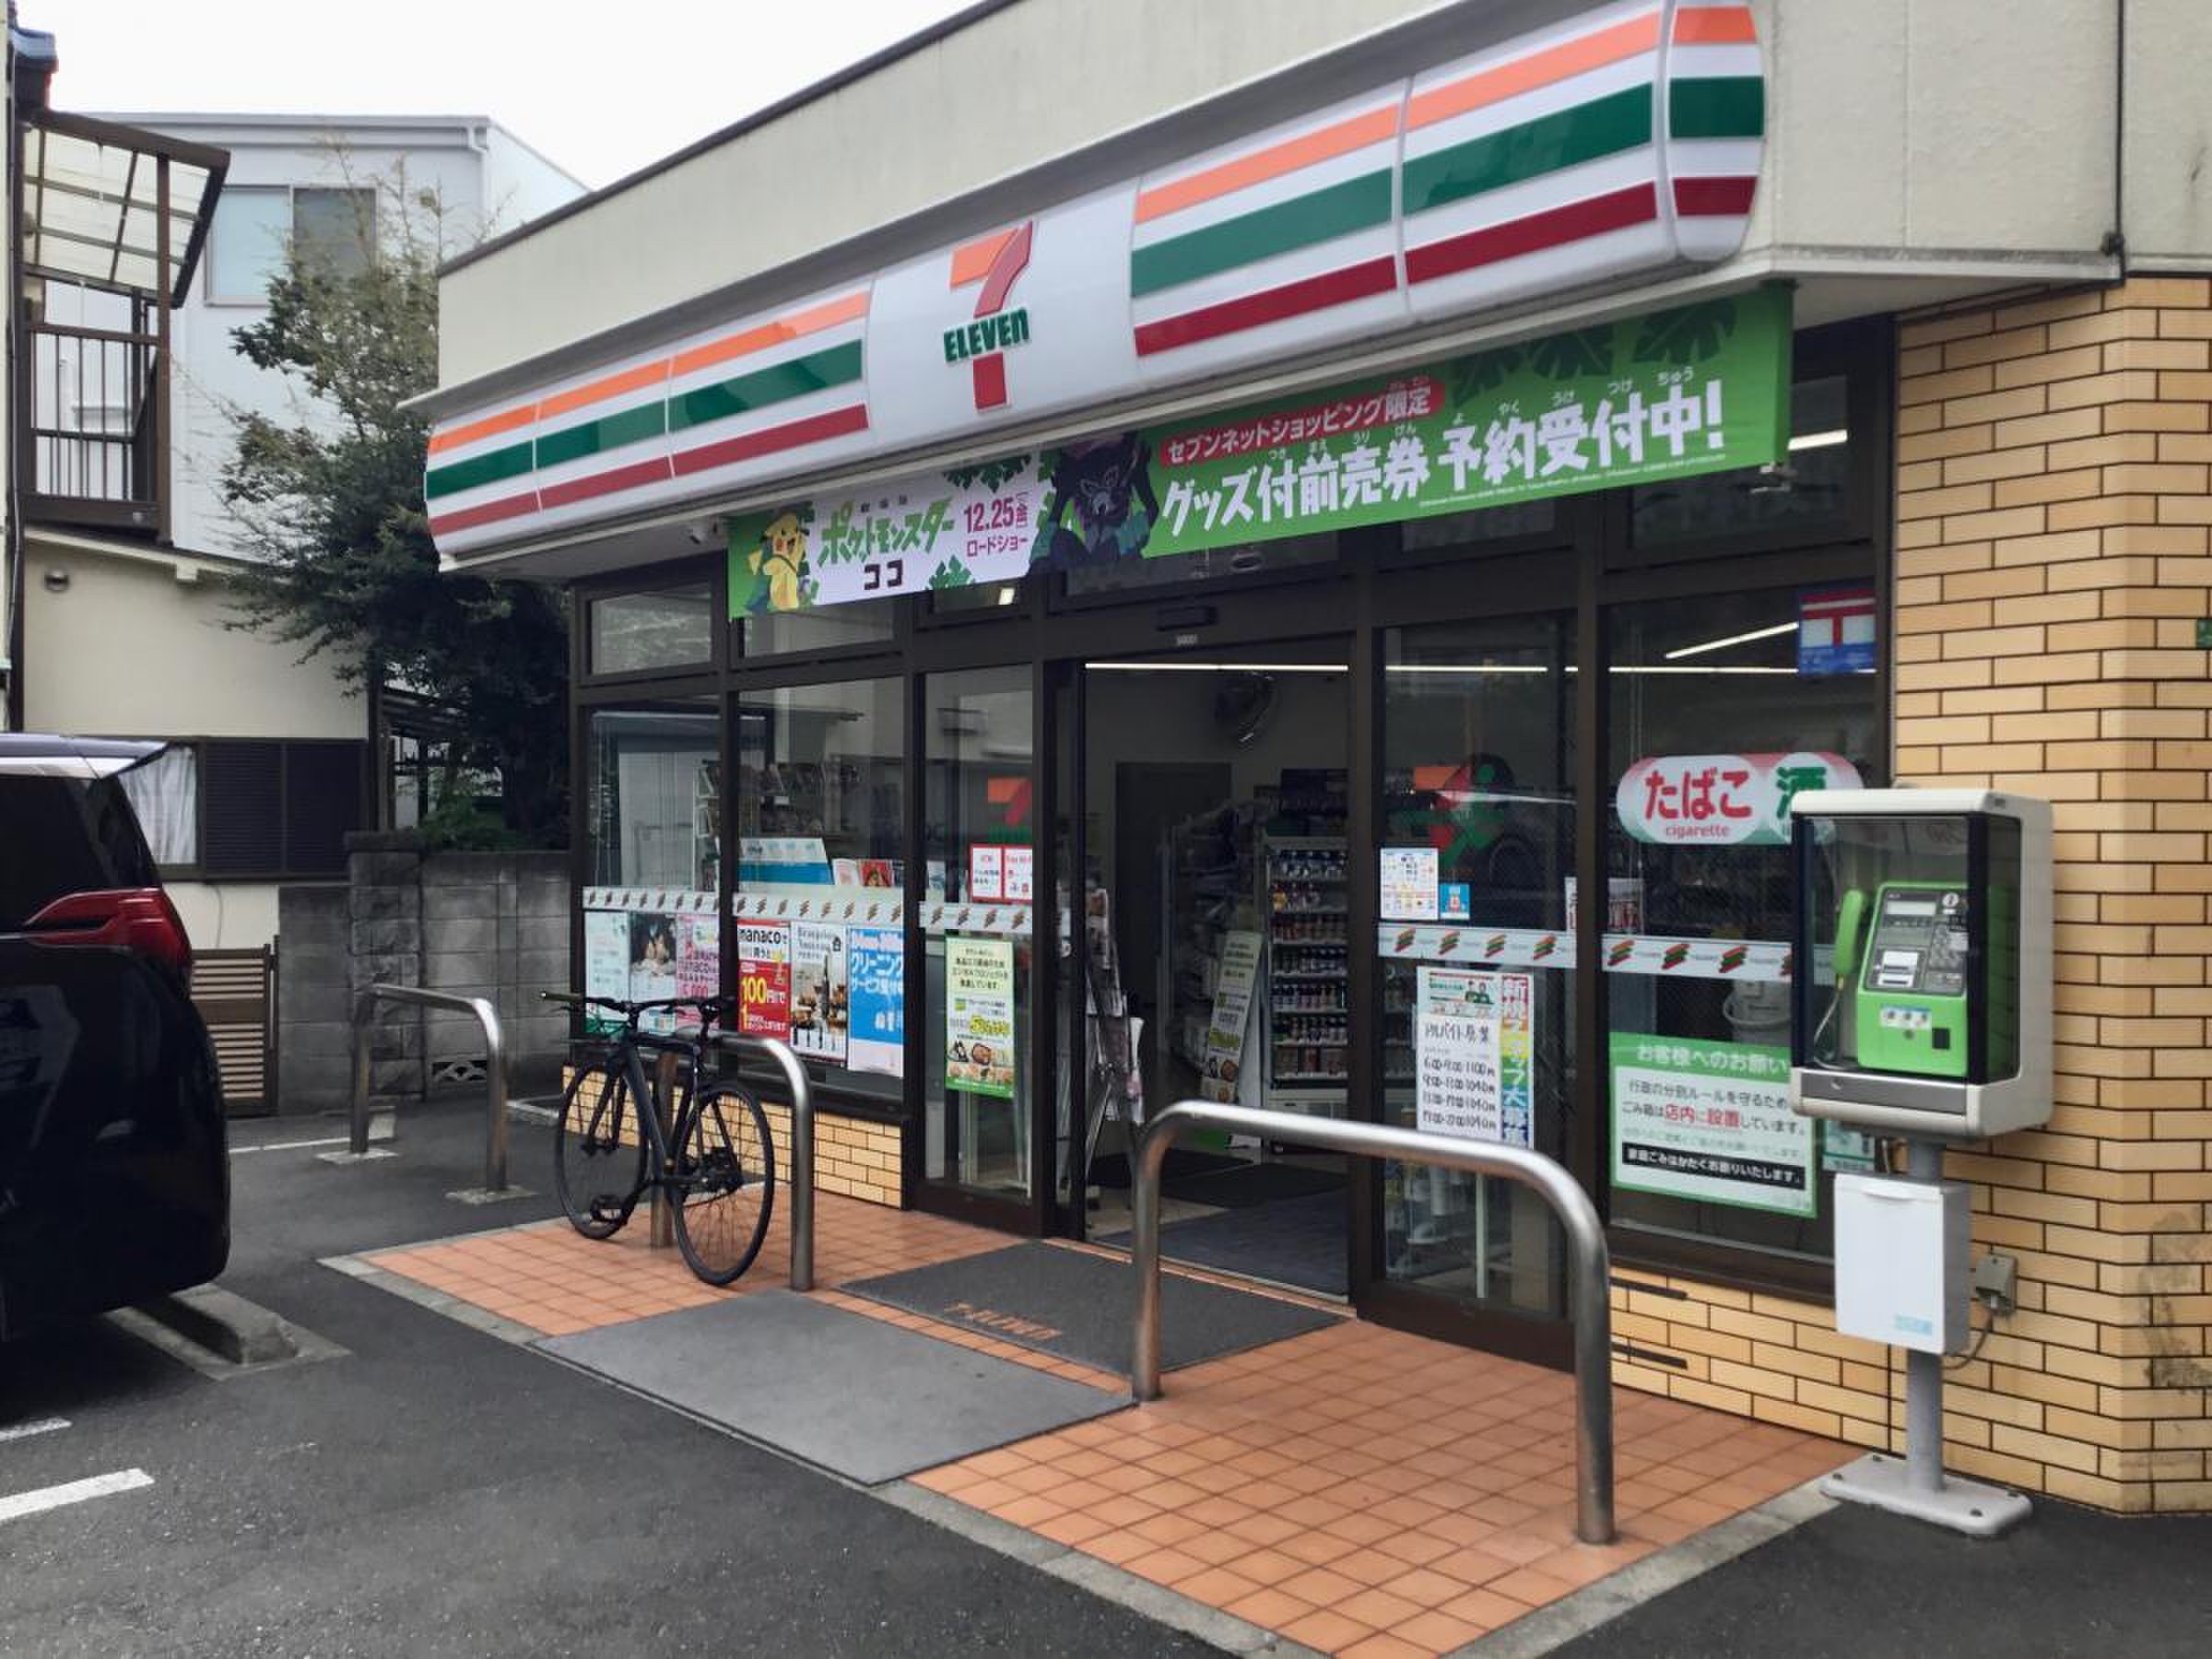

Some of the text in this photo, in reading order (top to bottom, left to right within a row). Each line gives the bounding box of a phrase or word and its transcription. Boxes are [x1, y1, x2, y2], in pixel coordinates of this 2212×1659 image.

[950, 220, 1033, 410] 7
[1168, 384, 1431, 464] セブンネットショッピング限定
[1162, 436, 1430, 537] グッズ付前売券
[818, 499, 955, 568] ポケットモンスター
[964, 496, 1013, 534] 12.25
[967, 536, 1030, 558] ロードショー
[864, 559, 903, 591] ココ
[1644, 767, 1753, 820] たばこ
[1665, 824, 1731, 840] cigarette
